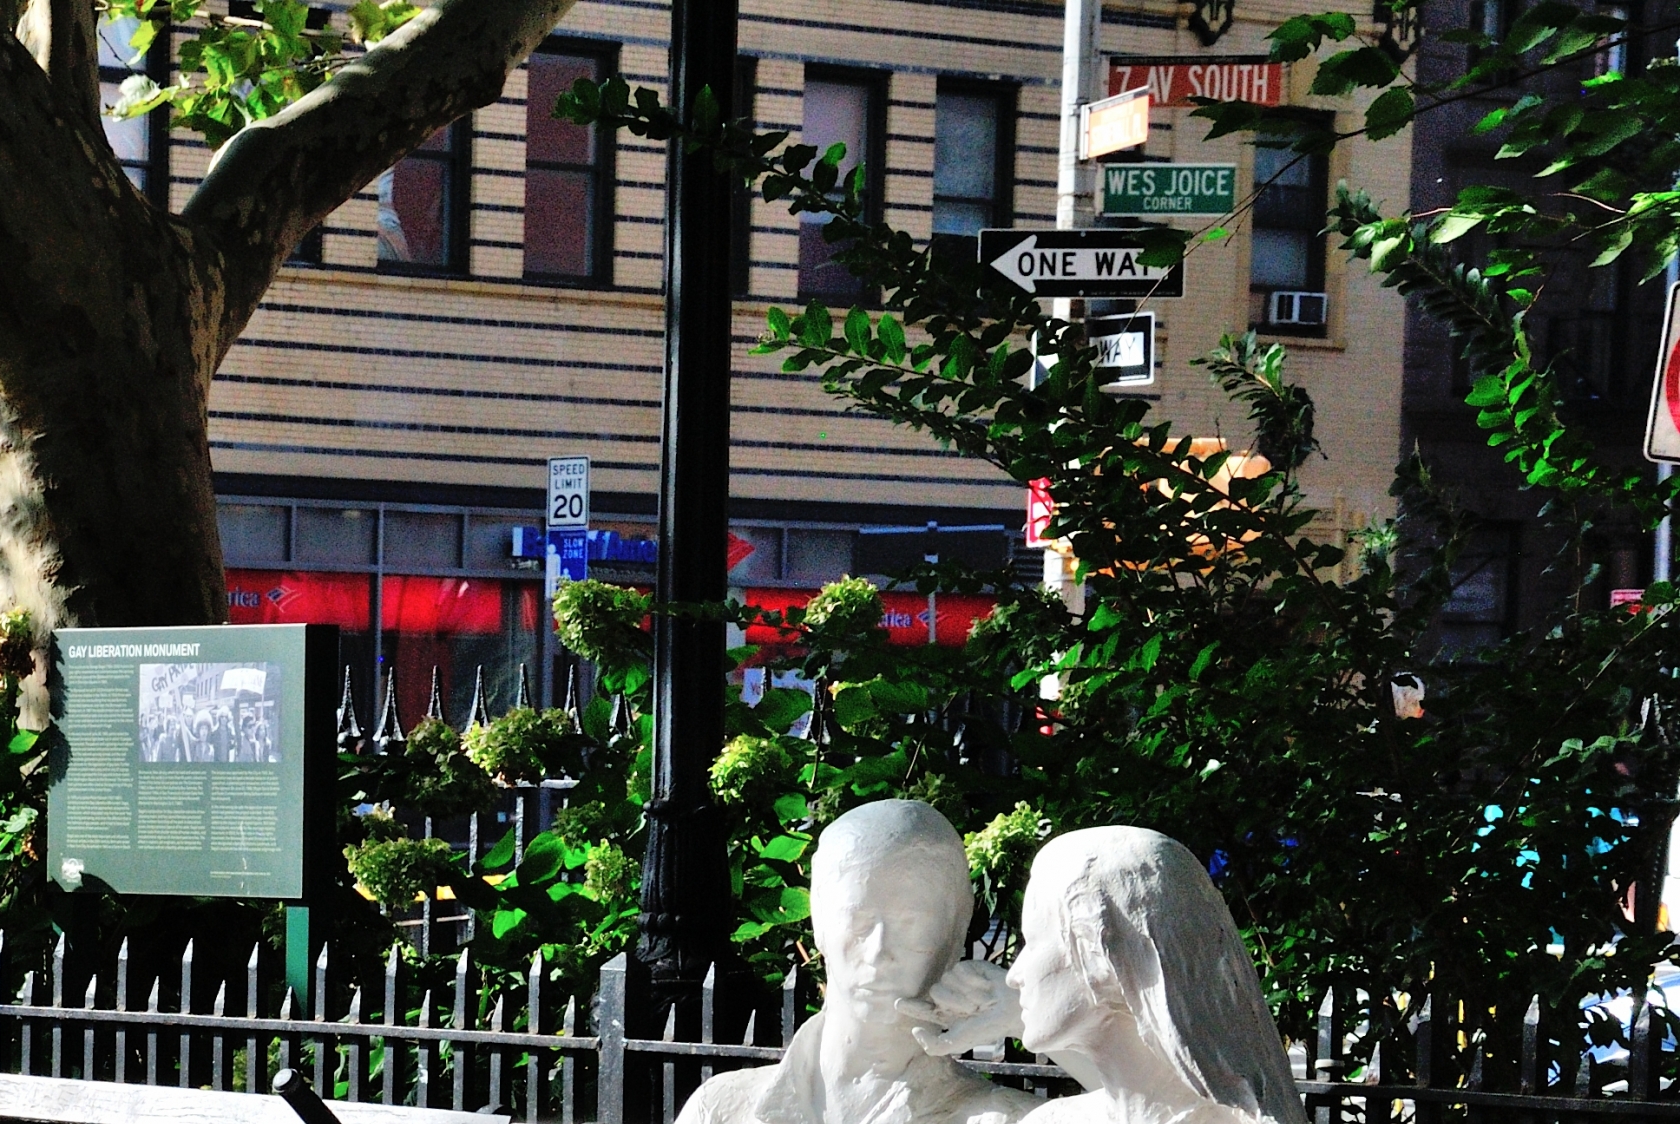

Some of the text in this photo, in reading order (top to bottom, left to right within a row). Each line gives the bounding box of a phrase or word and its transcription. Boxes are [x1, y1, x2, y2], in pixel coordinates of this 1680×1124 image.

[1147, 65, 1174, 103] AV
[1188, 65, 1268, 103] SOUTH
[1108, 170, 1230, 196] WES JOICE
[1143, 197, 1192, 210] CORNER
[1018, 252, 1076, 276] ONE
[1099, 337, 1136, 363] WAY
[553, 463, 585, 475] SPEED
[554, 478, 582, 489] LIMIT
[553, 494, 583, 519] 20
[563, 538, 585, 549] SLOW
[563, 549, 584, 559] ZONE
[68, 643, 200, 658] GAY LIBERATION MONUMENT
